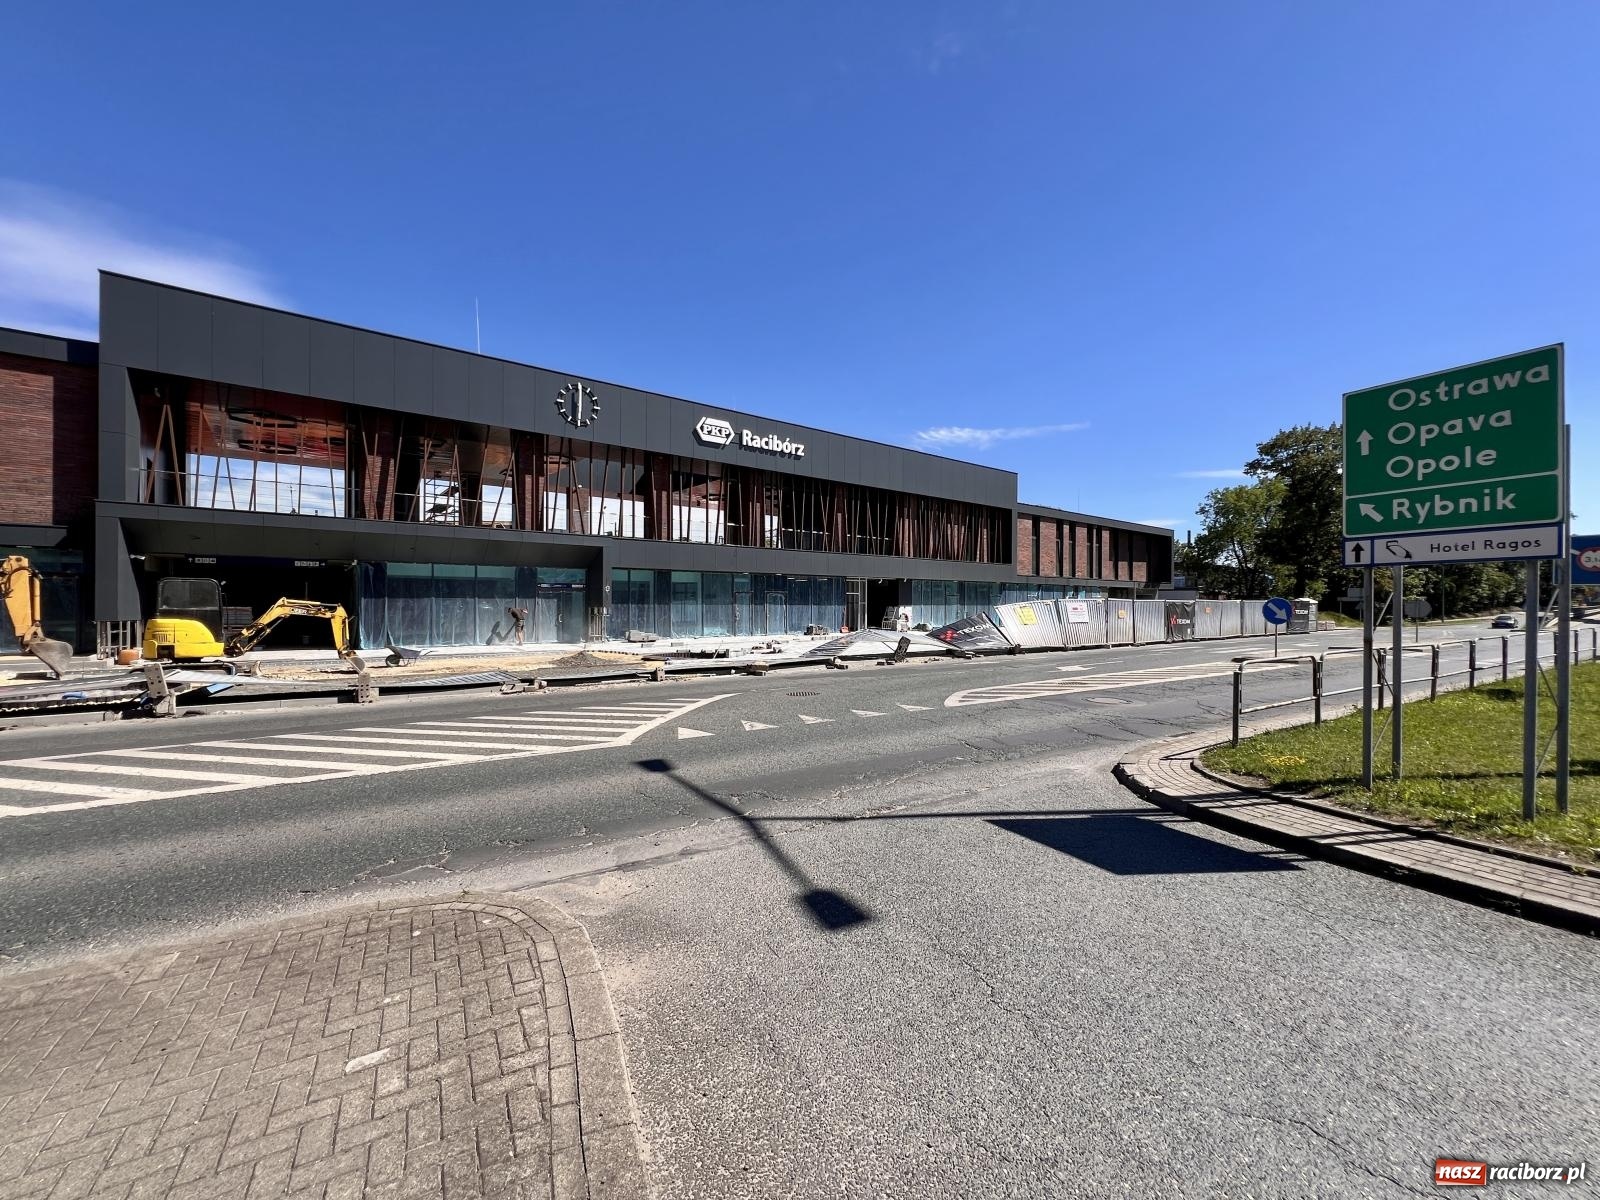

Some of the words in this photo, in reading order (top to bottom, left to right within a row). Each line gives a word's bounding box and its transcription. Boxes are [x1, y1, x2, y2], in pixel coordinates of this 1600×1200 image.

[1387, 364, 1551, 411] Ostrawa
[702, 424, 730, 438] PKP
[742, 429, 805, 456] Racibórz
[1387, 409, 1513, 447] Opava
[1386, 445, 1497, 481] Opole
[1392, 487, 1517, 524] Rybnik
[1430, 541, 1475, 553] Hotel
[1484, 539, 1542, 551] Ragos
